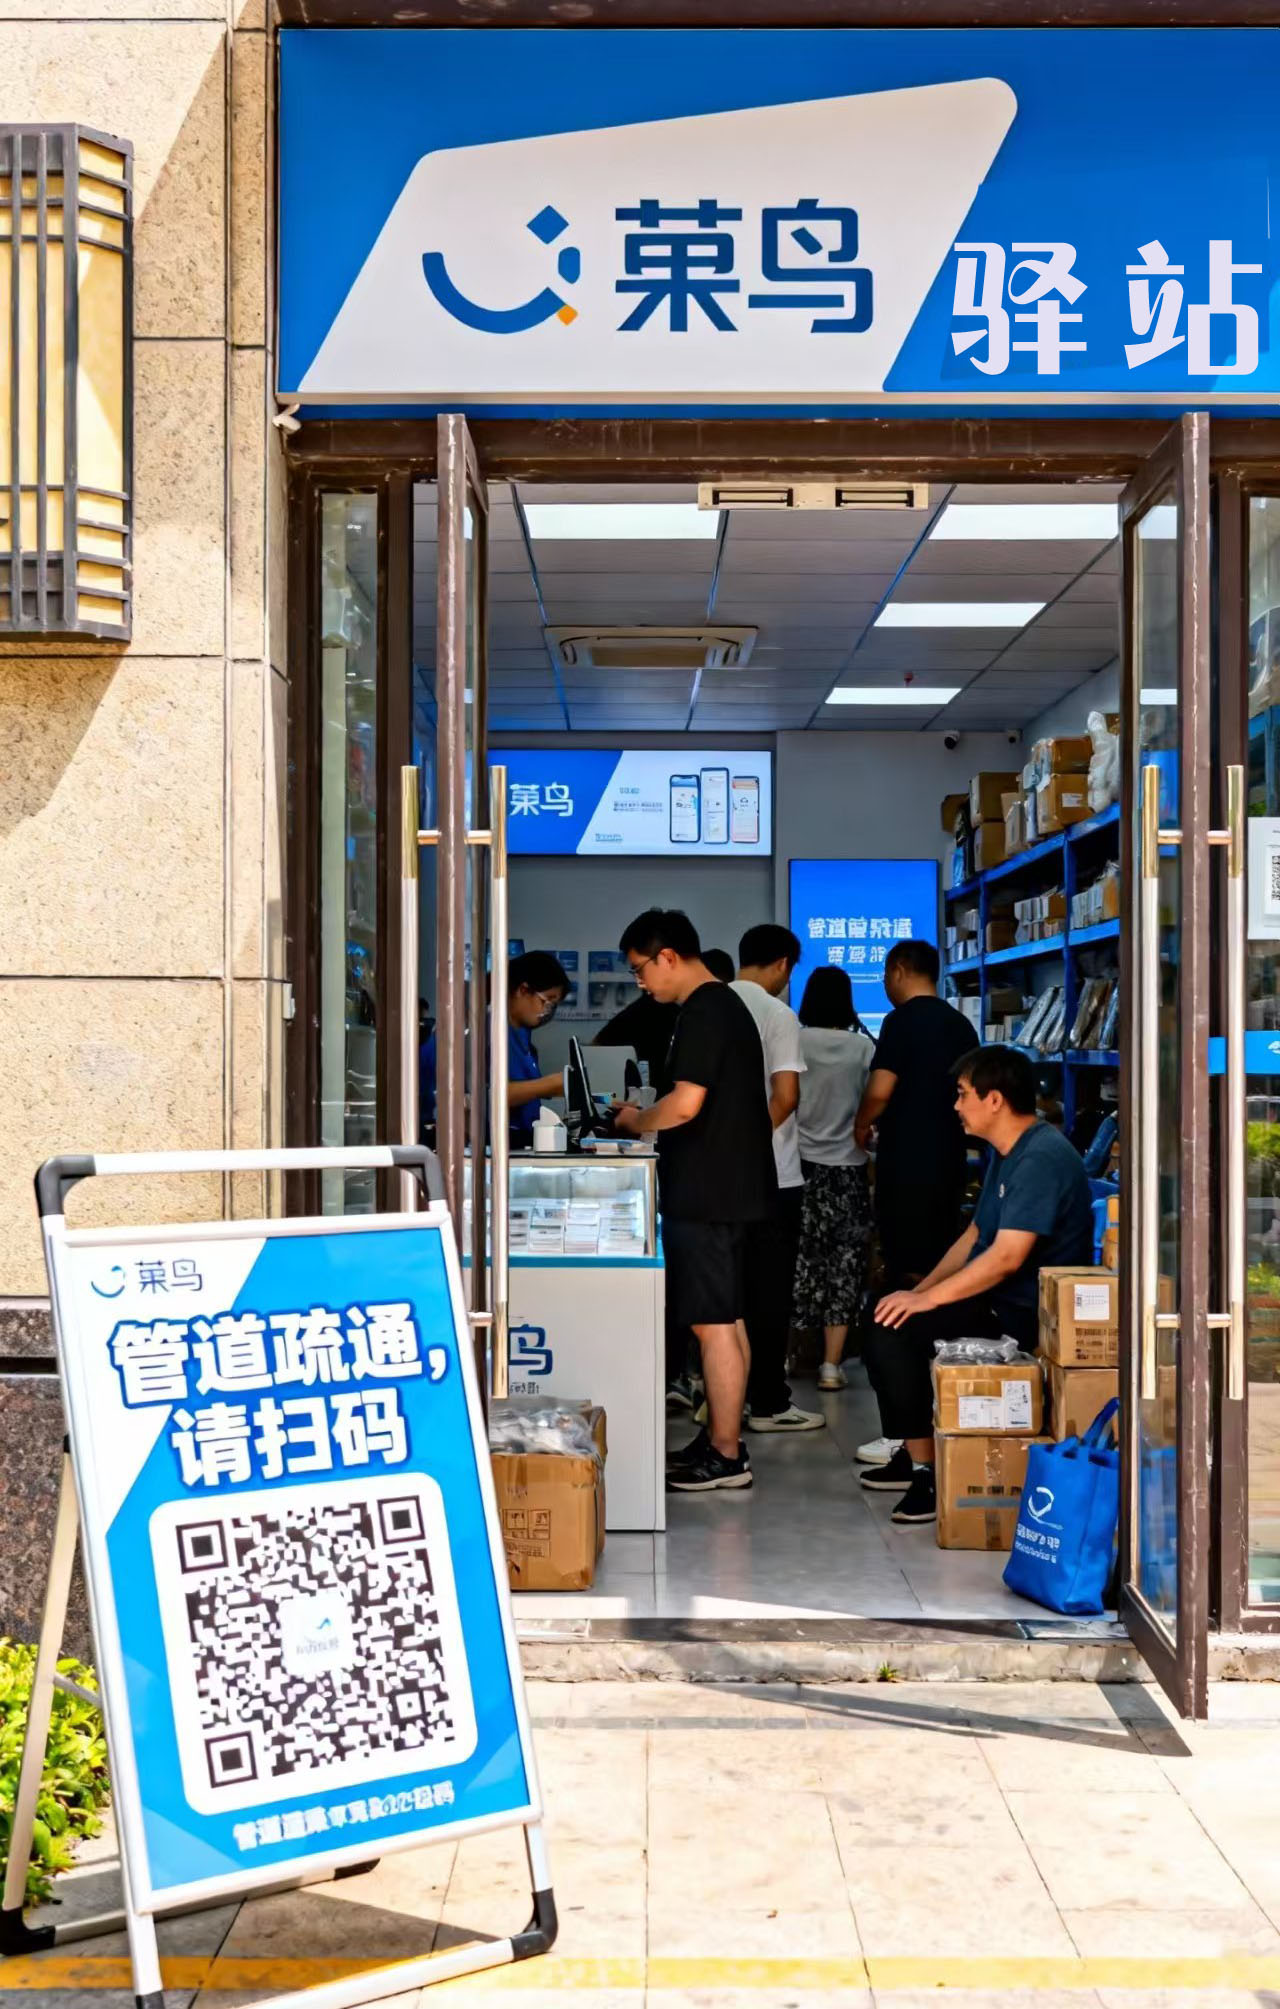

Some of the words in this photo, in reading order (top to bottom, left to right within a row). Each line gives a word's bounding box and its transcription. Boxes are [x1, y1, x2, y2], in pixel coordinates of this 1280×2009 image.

[951, 239, 1263, 376] 驿站
[171, 1386, 411, 1487] 请扫码
